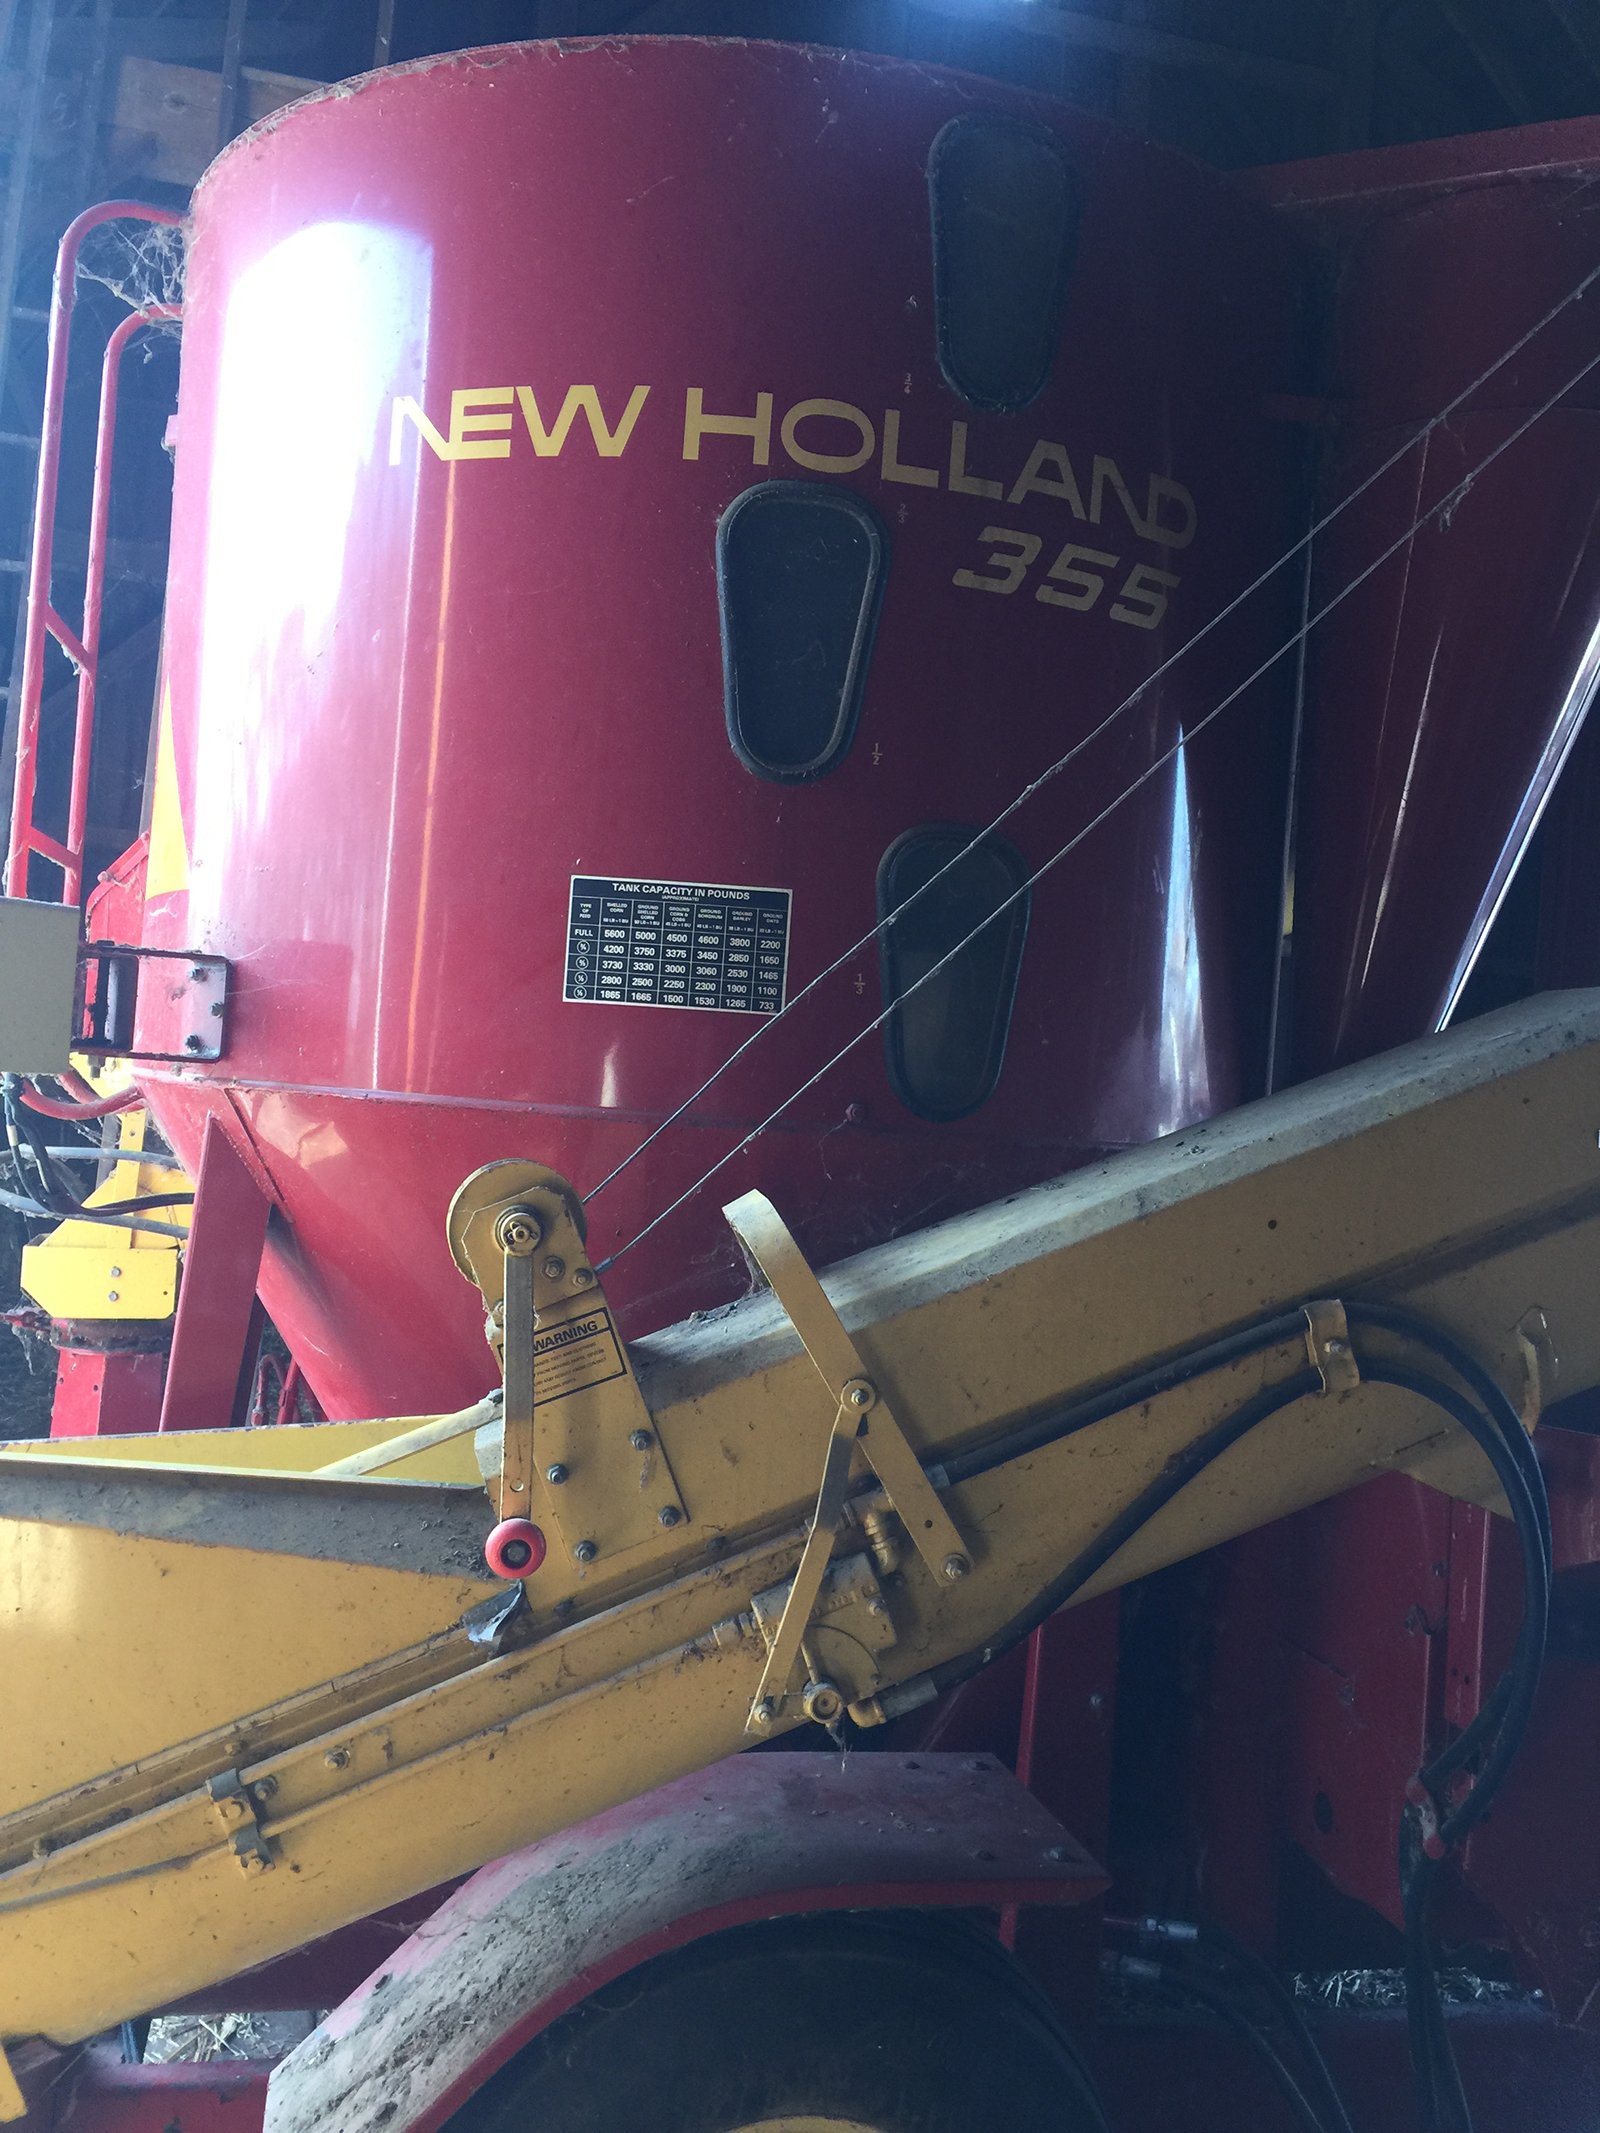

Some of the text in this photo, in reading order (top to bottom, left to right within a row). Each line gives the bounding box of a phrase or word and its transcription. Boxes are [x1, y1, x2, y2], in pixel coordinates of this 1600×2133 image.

[389, 384, 1197, 550] NEW HOLLAND
[952, 526, 1182, 630] 355
[612, 883, 750, 900] TANK CAPACITY IN POUNDS
[604, 930, 625, 938] 5600
[635, 932, 656, 940] 5000
[666, 934, 687, 942] 4500
[698, 936, 719, 944] 4600
[730, 938, 750, 947] 3800
[760, 940, 780, 949] 2200
[603, 945, 624, 954] 4200
[634, 947, 655, 955] 3750
[666, 949, 686, 958] 3375
[697, 951, 718, 960] 3450
[728, 954, 749, 962] 2850
[760, 956, 779, 964] 1650
[602, 961, 623, 969] 3730
[633, 962, 654, 971] 3330
[665, 965, 685, 973] 3000
[696, 967, 717, 975] 3060
[728, 969, 748, 978] 2530
[759, 972, 778, 980] 1465
[601, 976, 622, 984] 2800
[632, 978, 653, 986] 2500
[664, 980, 684, 988] 2250
[695, 982, 716, 991] 2300
[727, 985, 747, 993] 1900
[758, 987, 777, 995] 1100
[600, 991, 620, 999] 1865
[632, 993, 651, 1001] 1665
[663, 995, 683, 1003] 1500
[695, 997, 715, 1005] 1530
[726, 999, 746, 1008] 1265
[759, 1002, 774, 1010] 733
[534, 1320, 598, 1352] WARNING
